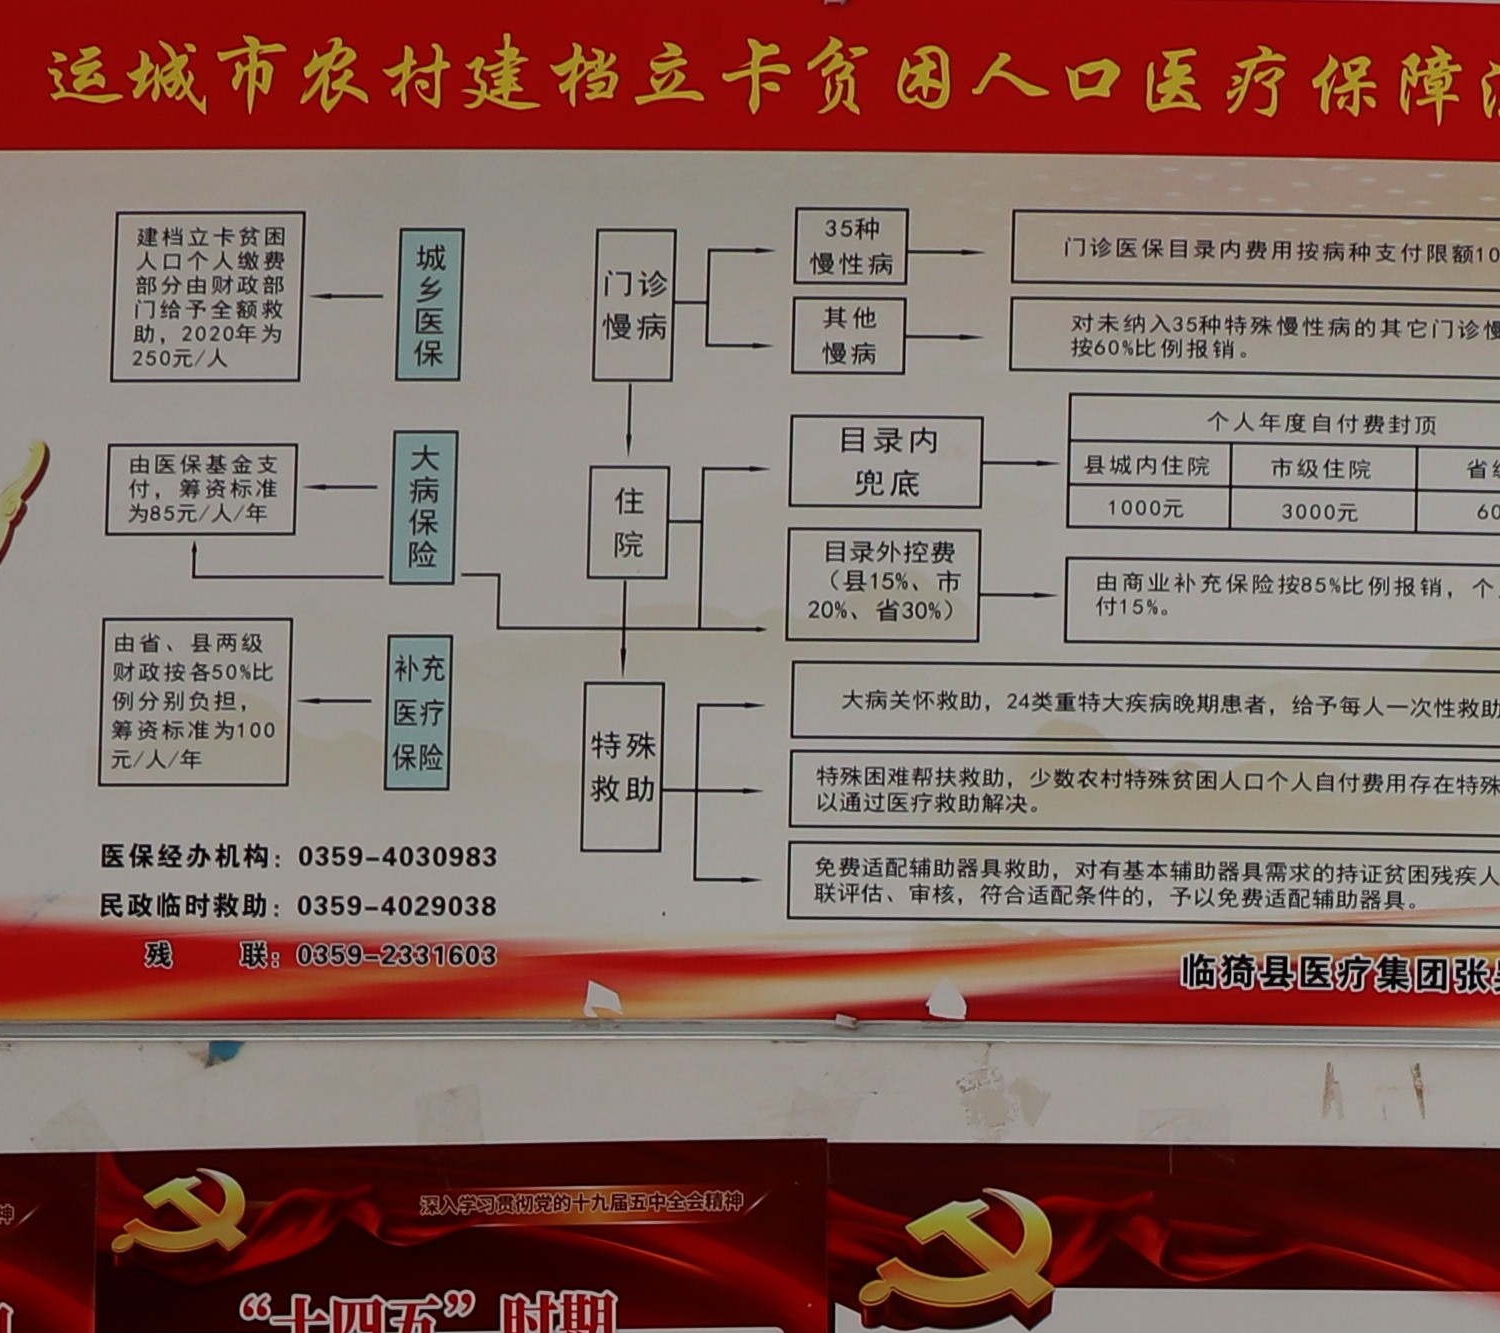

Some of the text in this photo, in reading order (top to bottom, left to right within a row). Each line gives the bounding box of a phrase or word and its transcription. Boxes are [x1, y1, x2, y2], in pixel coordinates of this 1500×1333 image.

[137, 227, 285, 247] 建档立卡贫困
[826, 218, 879, 240] 35种
[137, 251, 285, 270] 人口个人缴费
[810, 253, 892, 275] 慢性病
[136, 276, 284, 295] 部分由财政部
[603, 270, 668, 297] 门诊
[135, 300, 282, 319] 门给予全额救
[414, 244, 446, 367] 城乡医保
[603, 313, 668, 340] 慢病
[824, 307, 876, 328] 其他
[134, 324, 281, 343] 助，2020年为
[133, 349, 227, 367] 250元/人
[822, 342, 876, 365] 慢病
[1071, 337, 1246, 360] 按60%比例报销。
[1208, 412, 1435, 434] 个人年度自付费封顶
[842, 427, 937, 453] 目录内
[130, 454, 277, 474] 由医保基金支
[1085, 455, 1209, 476] 县城内住院
[1272, 459, 1371, 479] 市级住院
[129, 479, 277, 499] 付，筹资标准
[856, 470, 919, 496] 兜底
[129, 503, 267, 523] 为85元/人/年
[409, 444, 440, 568] 大病保险
[1110, 499, 1183, 518] 1000元
[1283, 503, 1358, 522] 3000元
[826, 541, 955, 564] 目录外控费
[1096, 597, 1167, 617] 付15%。
[115, 633, 262, 653] 由省、县两级
[114, 662, 273, 682] 财政按各50%比
[394, 655, 444, 681] 补充
[113, 691, 246, 711] 例分别负担，
[393, 699, 444, 726] 医疗
[112, 720, 275, 740] 筹资标准为100
[592, 732, 656, 759] 特殊
[111, 748, 202, 768] 元/人/年
[393, 744, 443, 771] 保险
[590, 776, 656, 802] 救助
[818, 791, 1037, 815] 以通过医疗救助解决。
[144, 940, 173, 969] 残
[420, 1191, 743, 1215] 深入学习贯彻党的十九届五中全会精神
